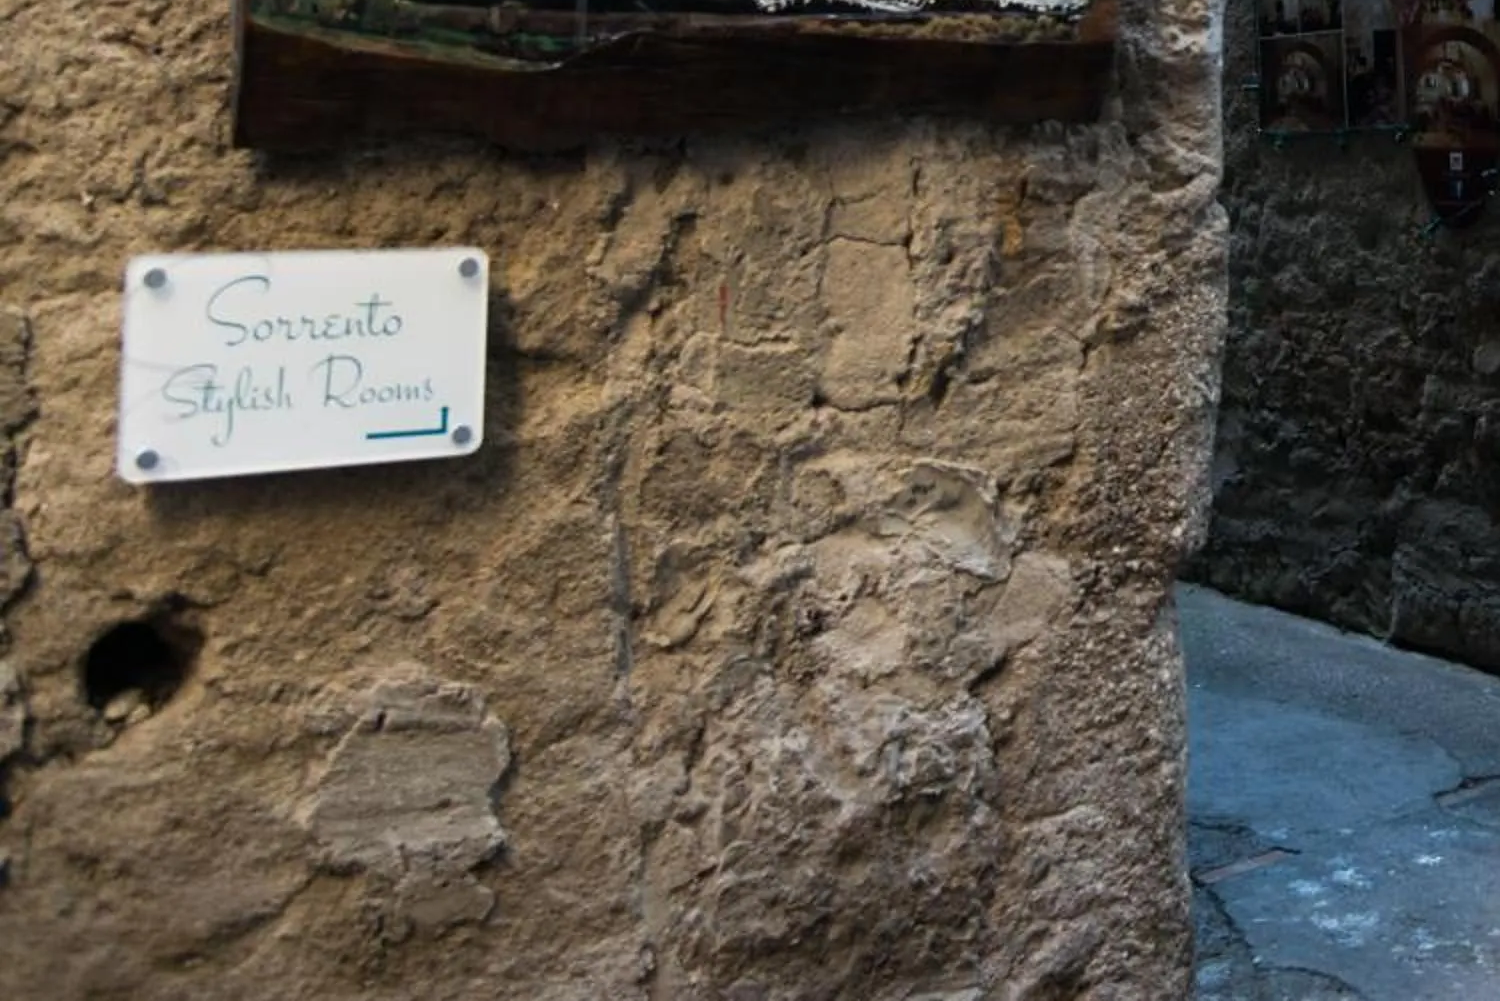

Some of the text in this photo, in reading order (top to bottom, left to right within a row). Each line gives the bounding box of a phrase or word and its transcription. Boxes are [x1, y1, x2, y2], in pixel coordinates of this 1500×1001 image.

[206, 274, 404, 347] Sorrento
[160, 353, 435, 447] Stylish Rooms
